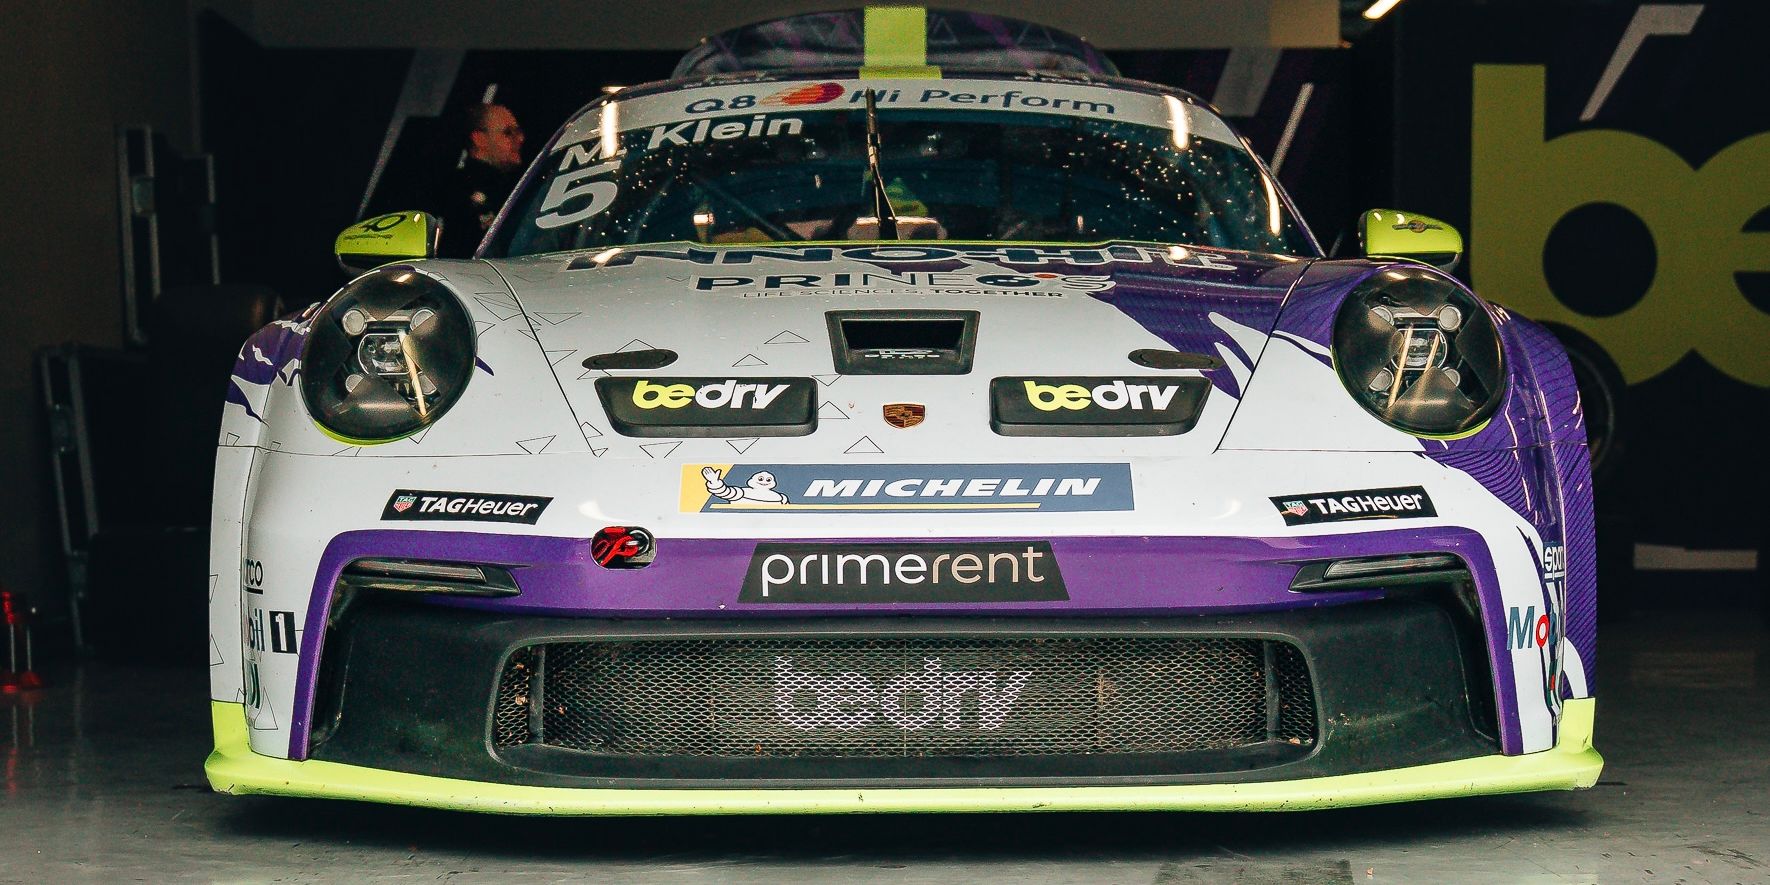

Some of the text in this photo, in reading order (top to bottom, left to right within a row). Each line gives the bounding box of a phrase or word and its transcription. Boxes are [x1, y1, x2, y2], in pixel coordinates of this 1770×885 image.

[685, 89, 1115, 114] Q8 Hi Perform
[647, 114, 803, 150] Klein
[535, 160, 622, 229] 5
[930, 288, 1063, 298] TOGETHER
[802, 477, 1101, 498] MICHELIN
[761, 546, 1046, 597] primerent
[275, 612, 288, 651] 1
